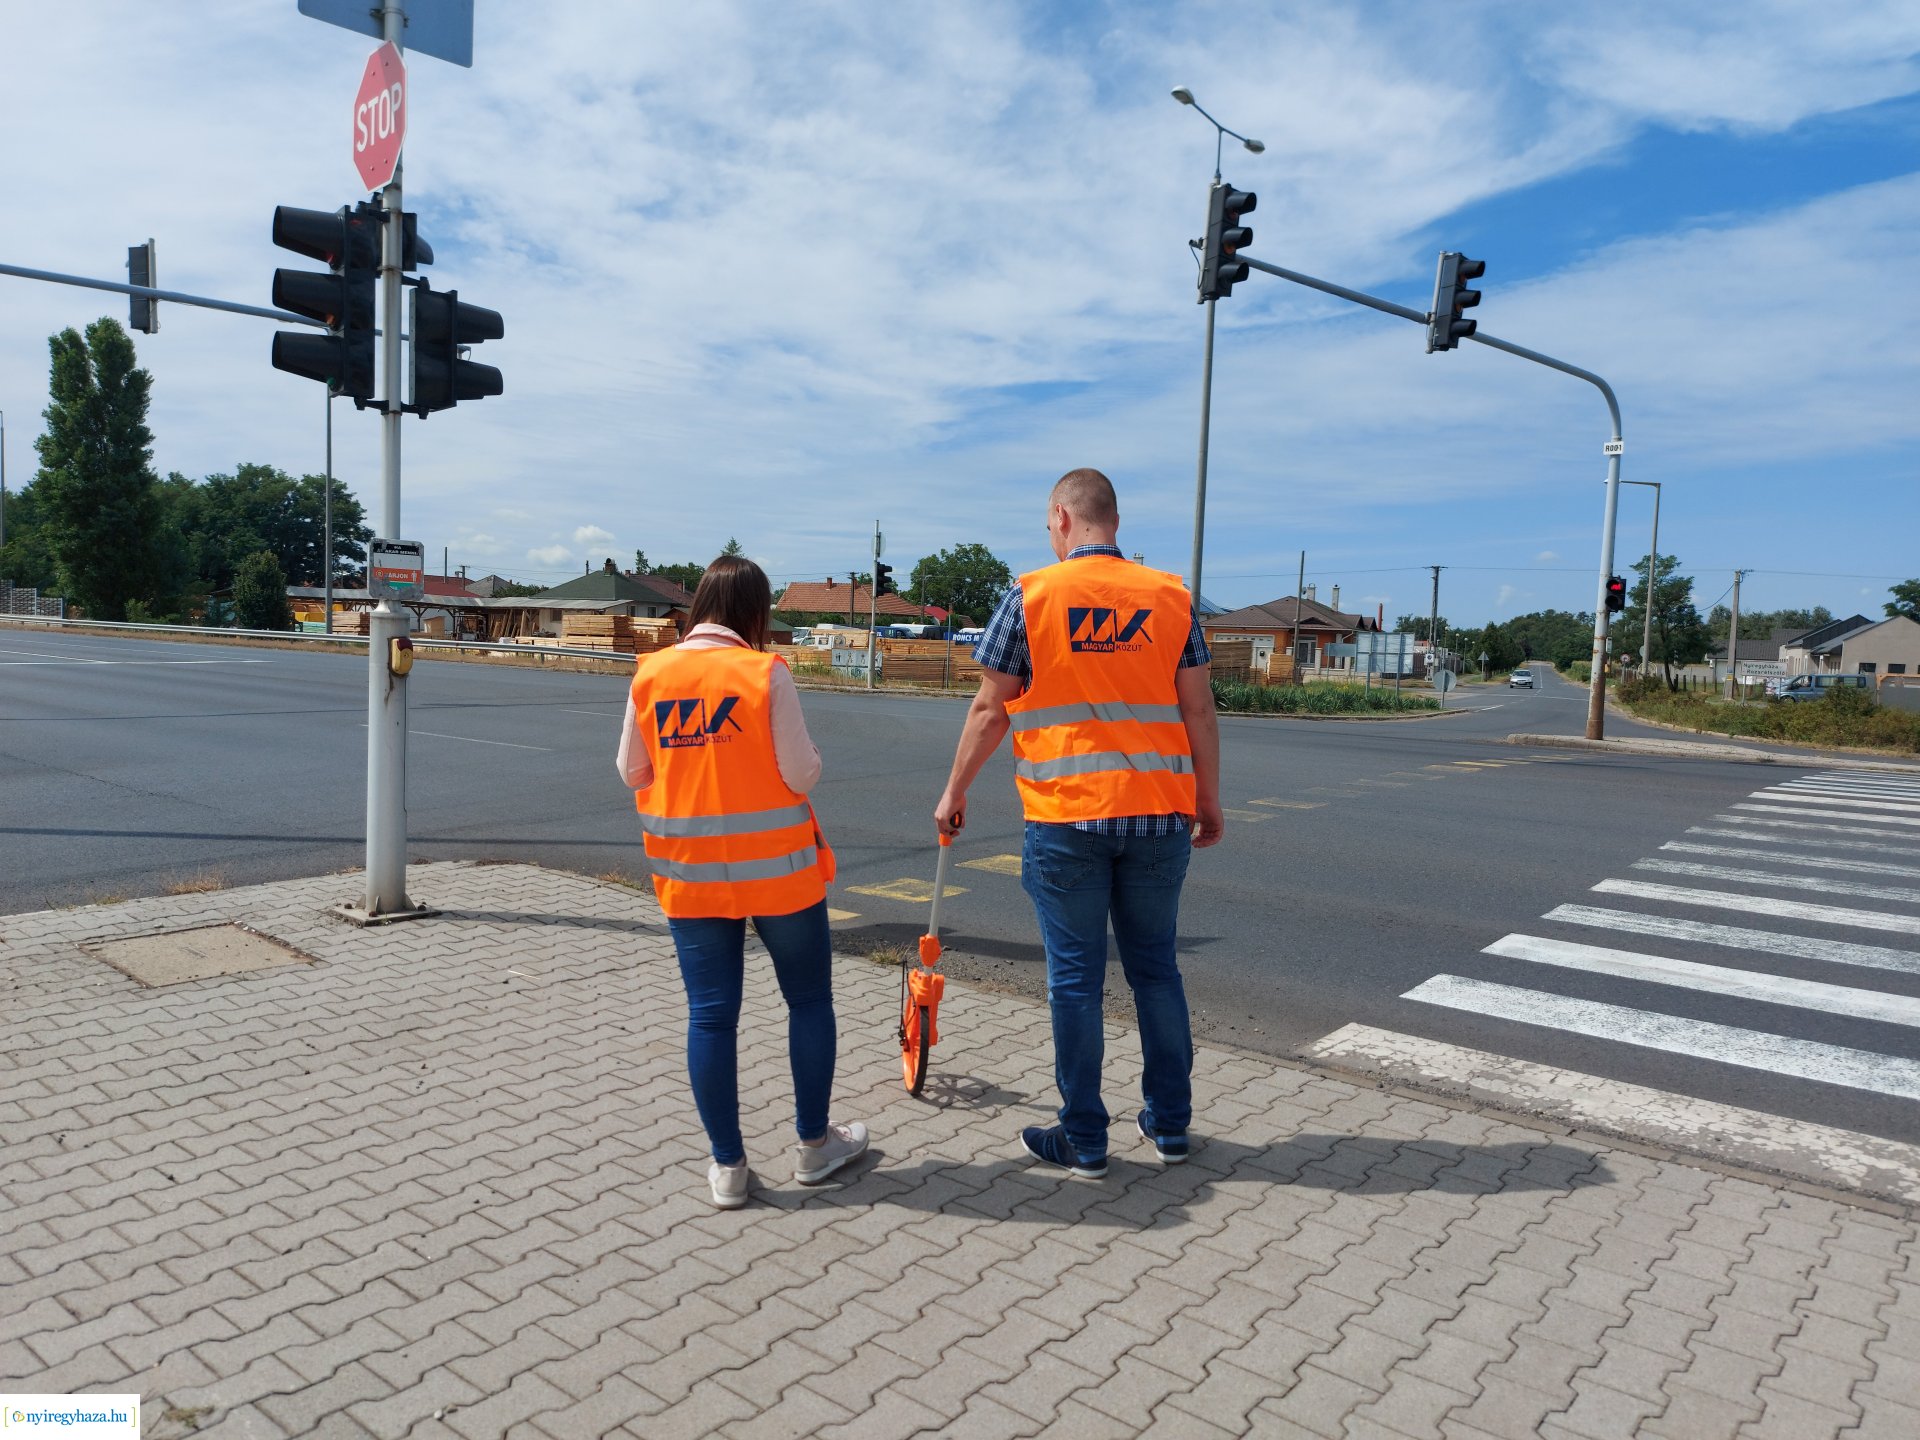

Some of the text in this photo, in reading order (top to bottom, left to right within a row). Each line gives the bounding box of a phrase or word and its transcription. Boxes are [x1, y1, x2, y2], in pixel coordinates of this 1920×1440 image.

[357, 82, 402, 152] STOP
[1081, 642, 1114, 651] MAGYAR
[668, 737, 704, 747] MAGYAR
